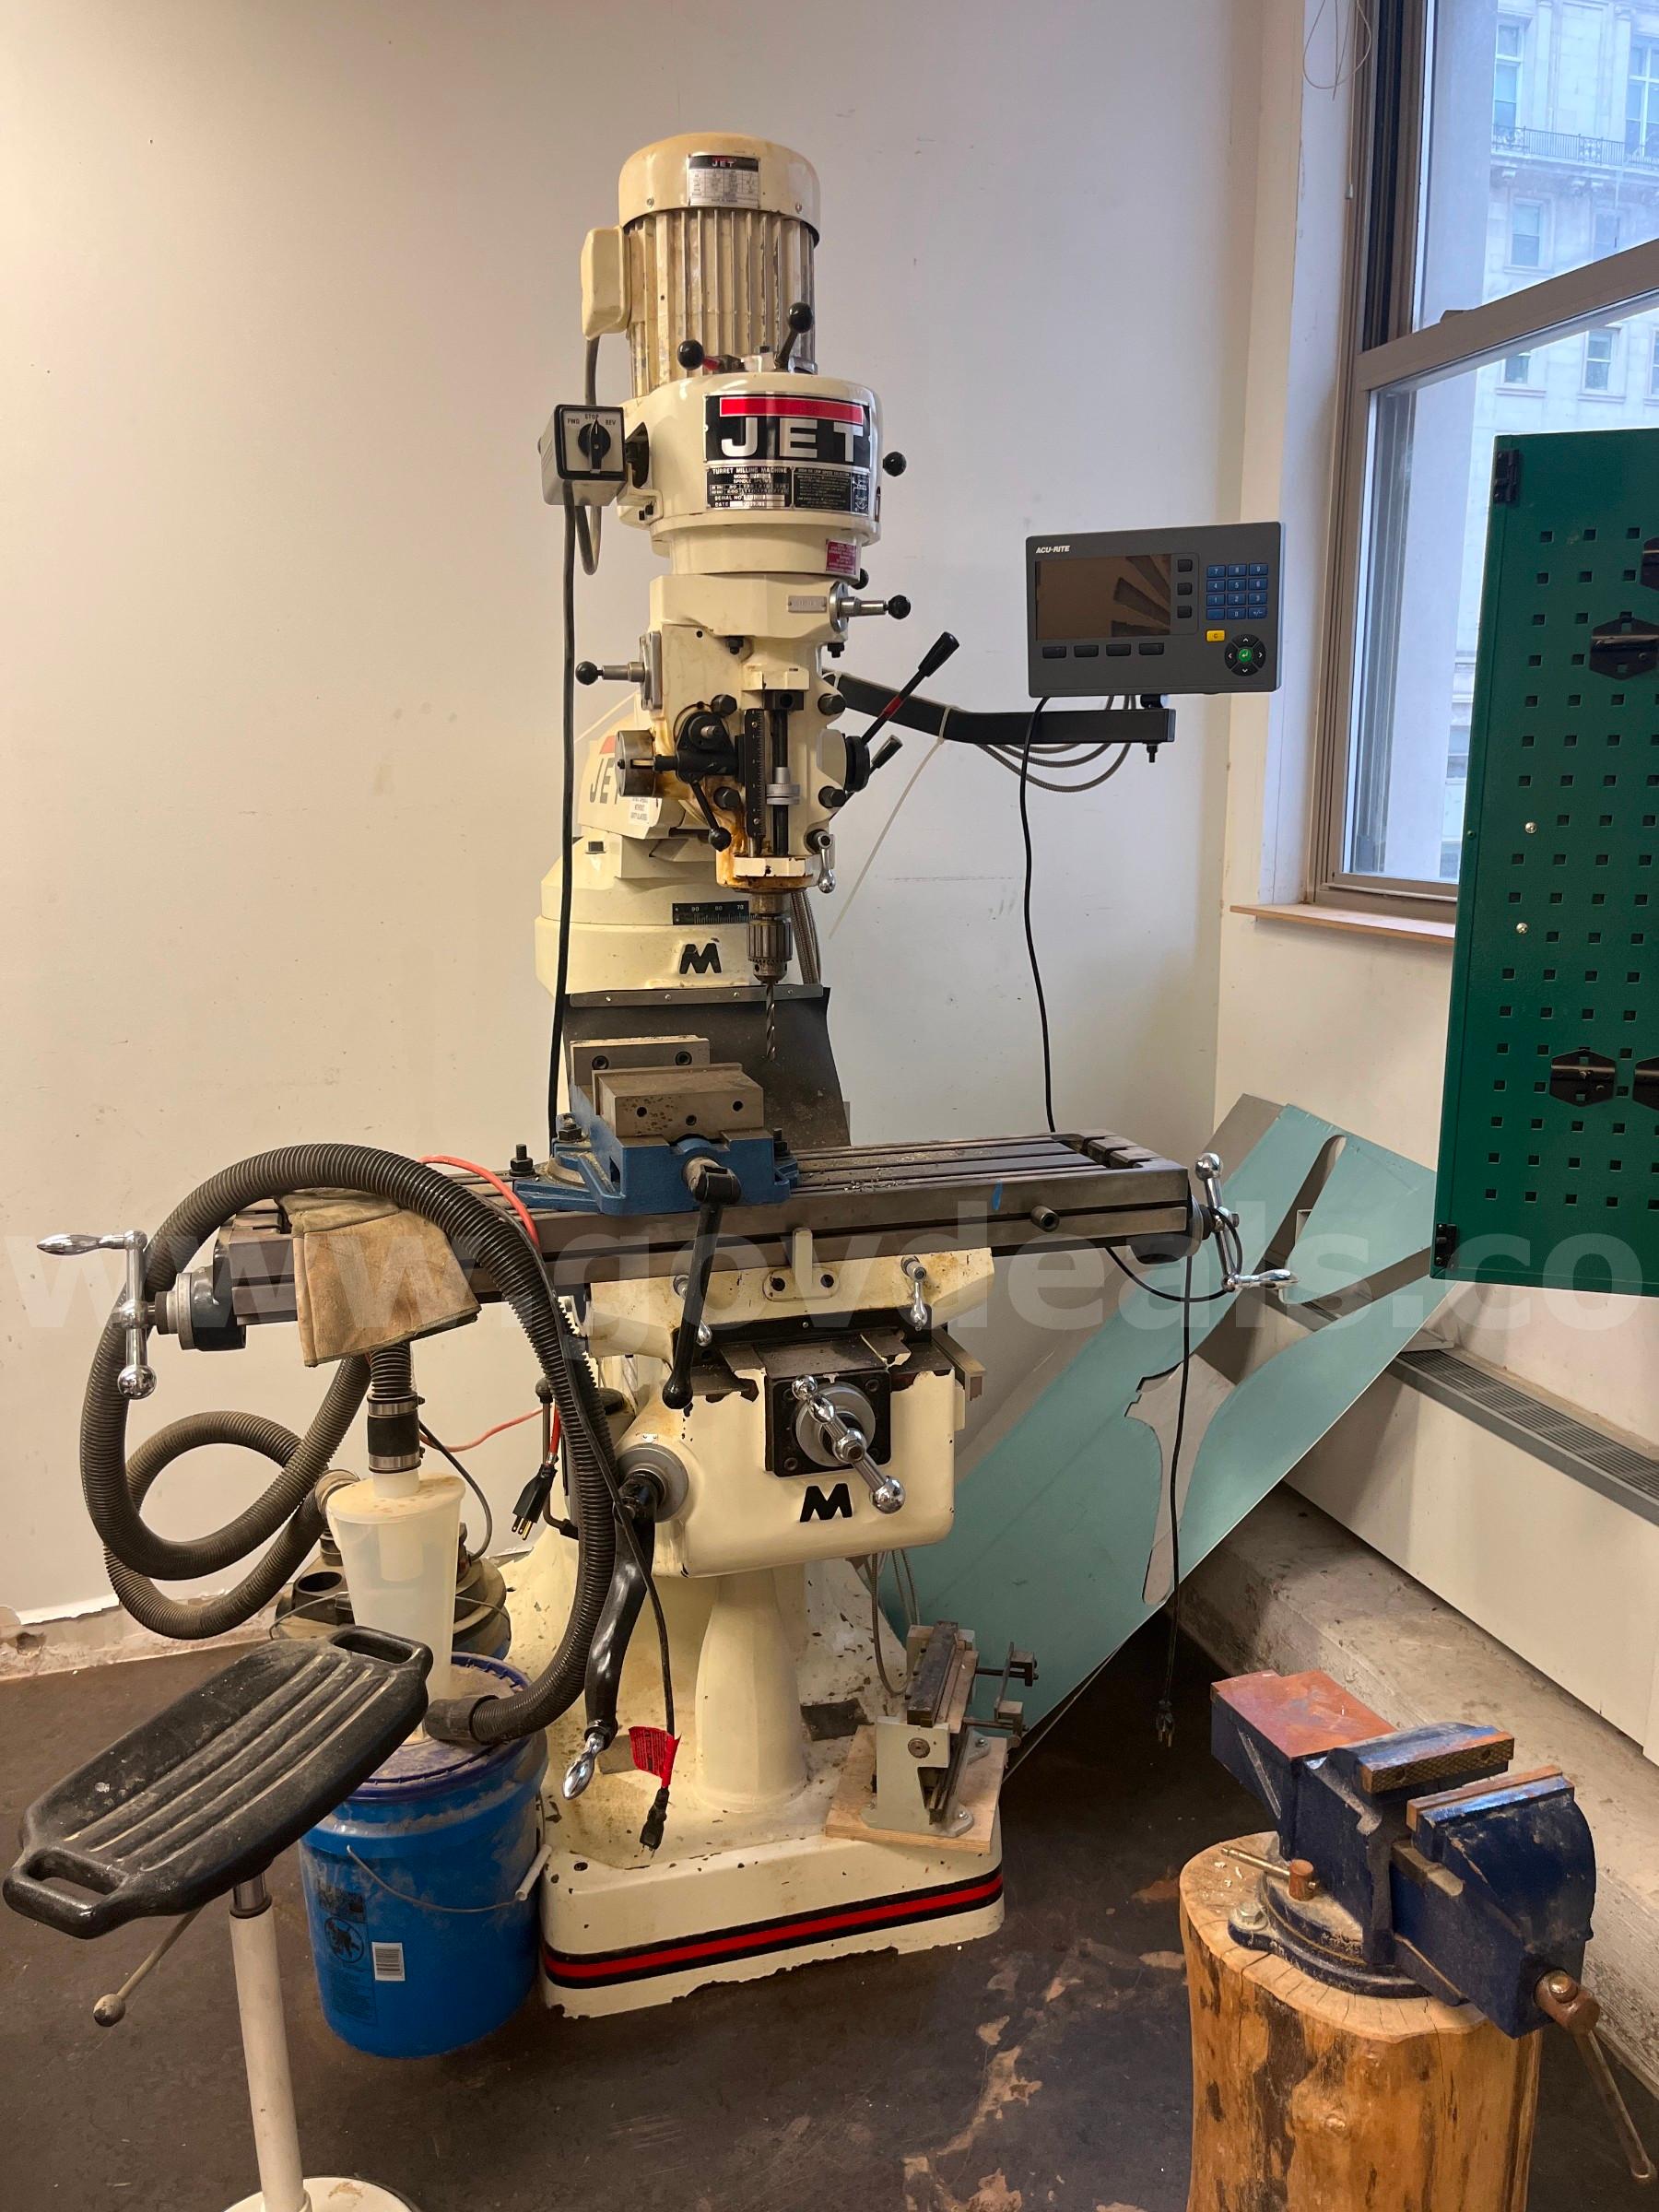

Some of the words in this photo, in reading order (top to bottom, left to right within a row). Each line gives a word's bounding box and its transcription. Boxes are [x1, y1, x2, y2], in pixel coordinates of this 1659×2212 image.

[721, 417, 864, 463] JET
[1035, 545, 1071, 554] ACU-RITE
[589, 757, 618, 806] JE
